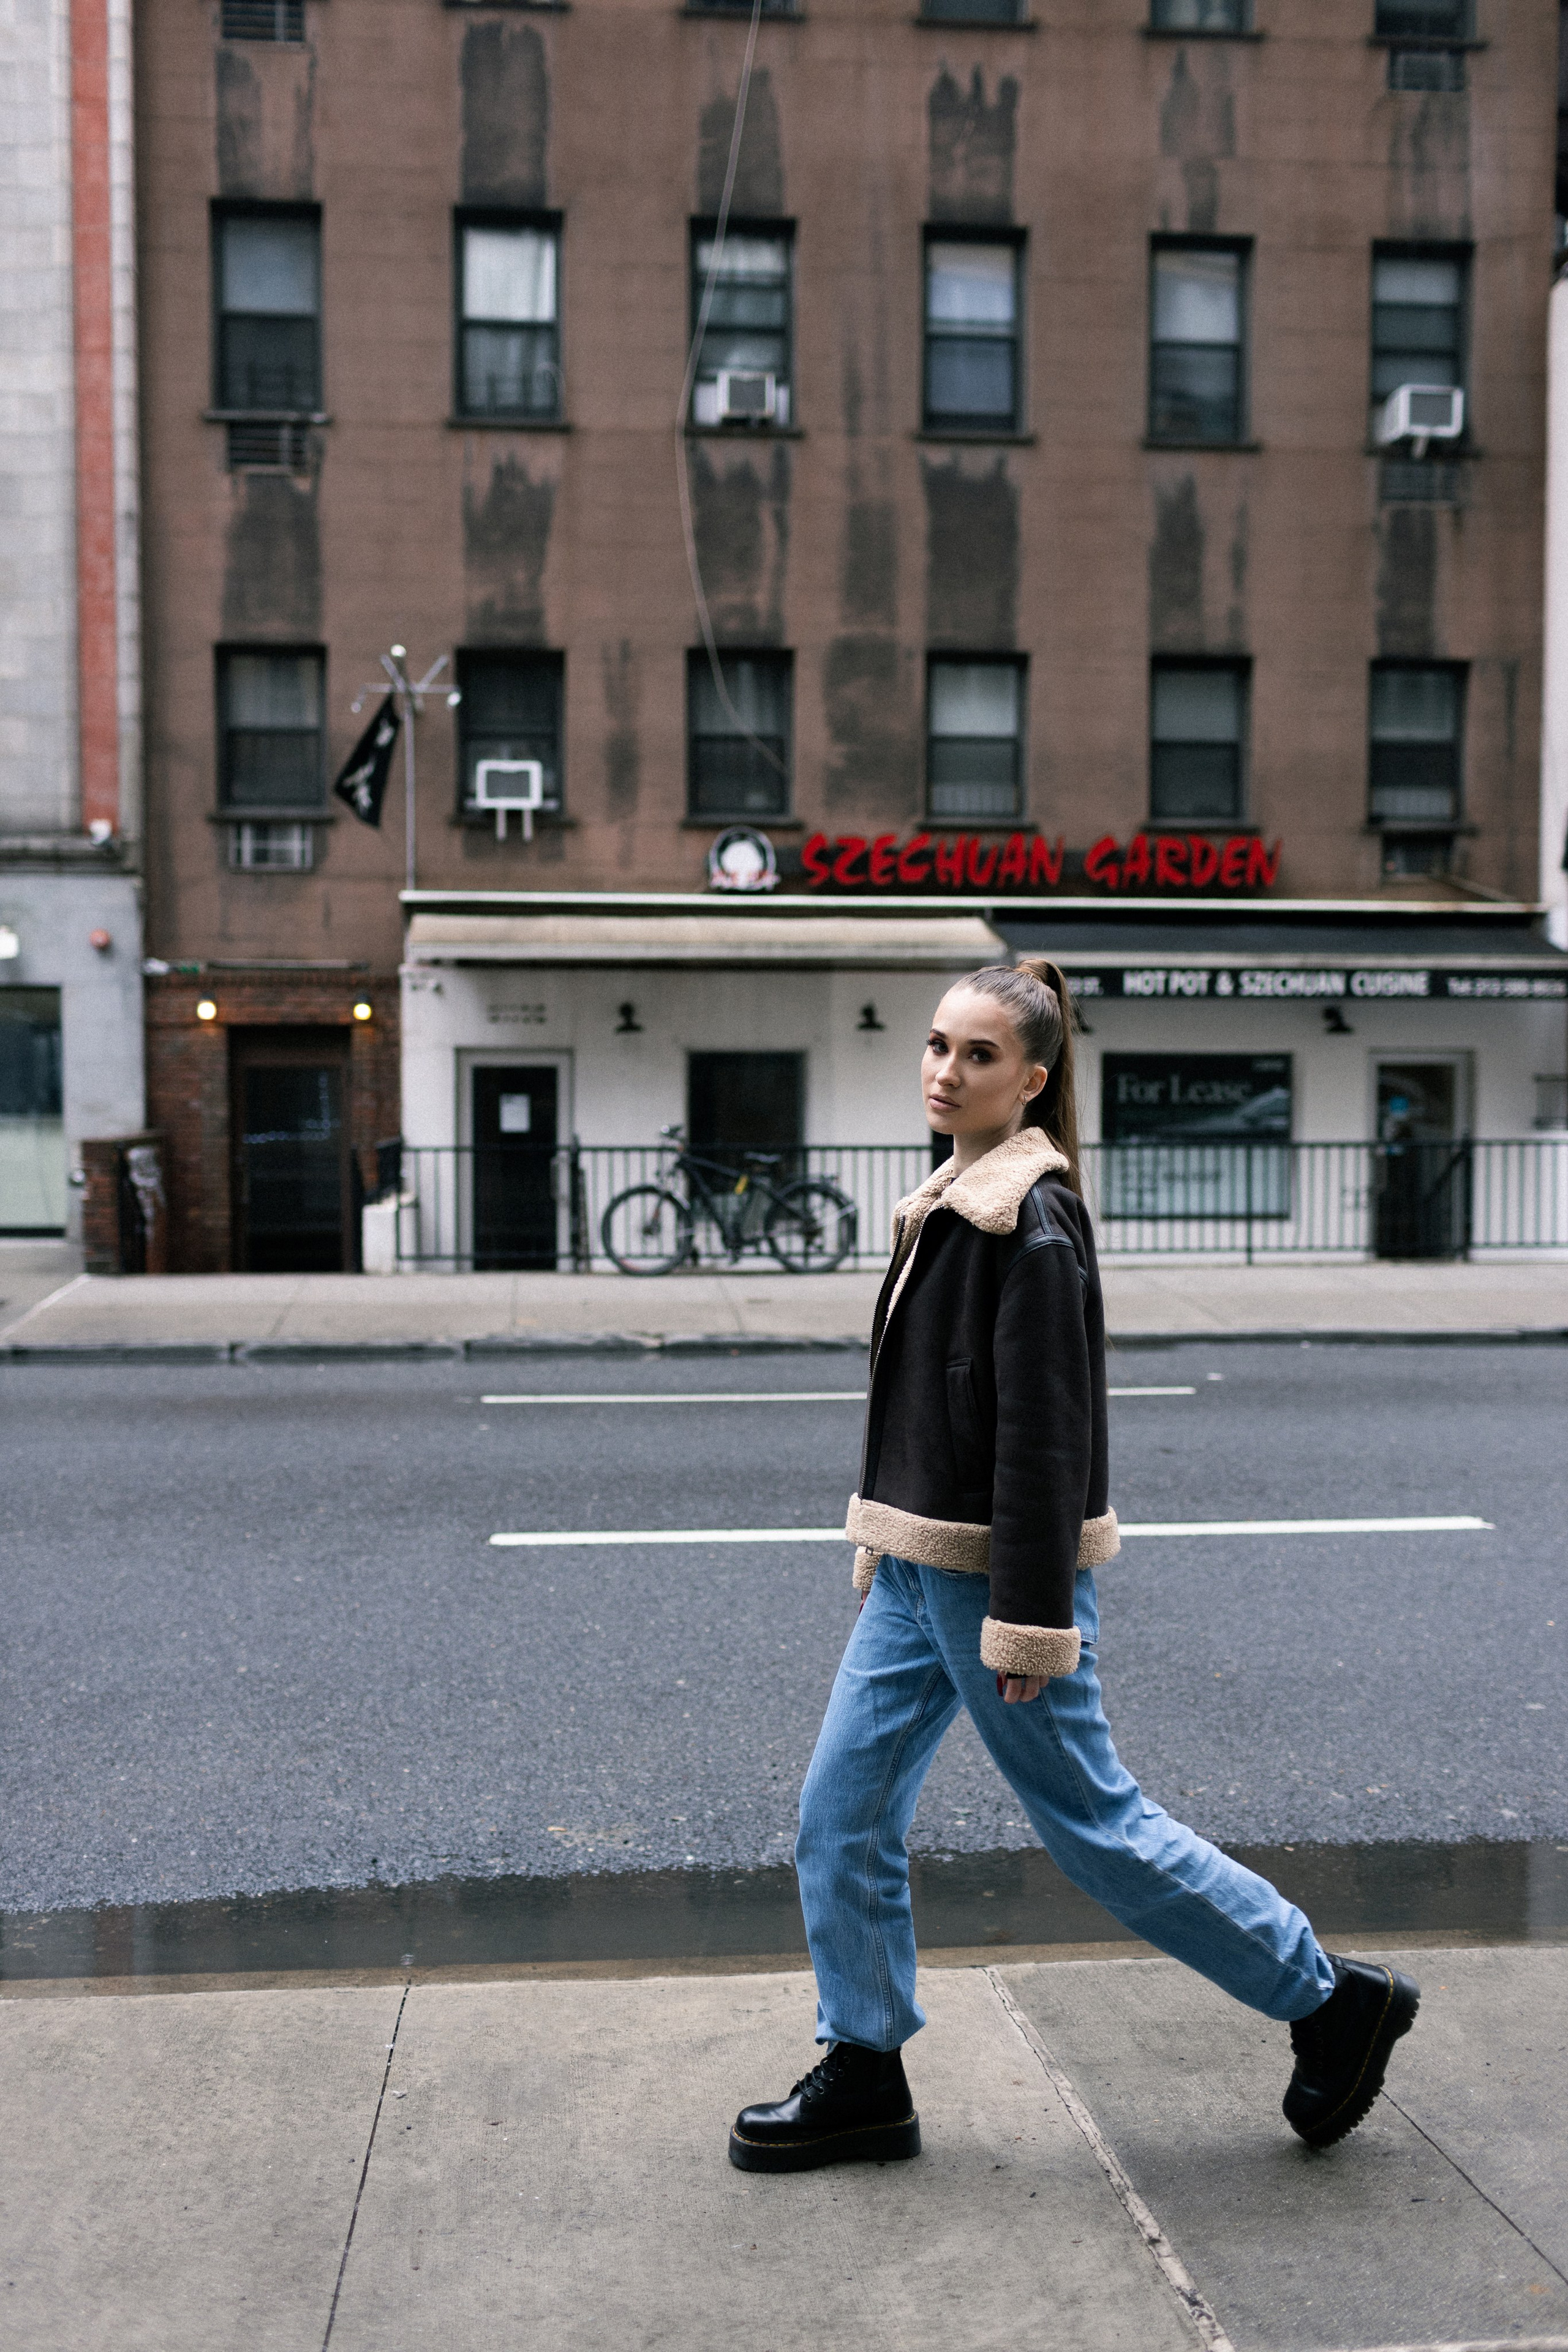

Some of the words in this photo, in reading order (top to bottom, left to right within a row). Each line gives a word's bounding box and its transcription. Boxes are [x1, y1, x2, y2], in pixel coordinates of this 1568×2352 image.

[801, 832, 1064, 886] SZECHUAN
[1084, 833, 1282, 889] GARDEN
[1123, 971, 1167, 995] HOT
[1169, 971, 1210, 995] POT
[1215, 971, 1234, 995] &
[1239, 971, 1346, 996] SZECHUAN
[1351, 971, 1430, 996] CUISINE
[1117, 1073, 1165, 1103] For
[1170, 1074, 1251, 1104] Lease
